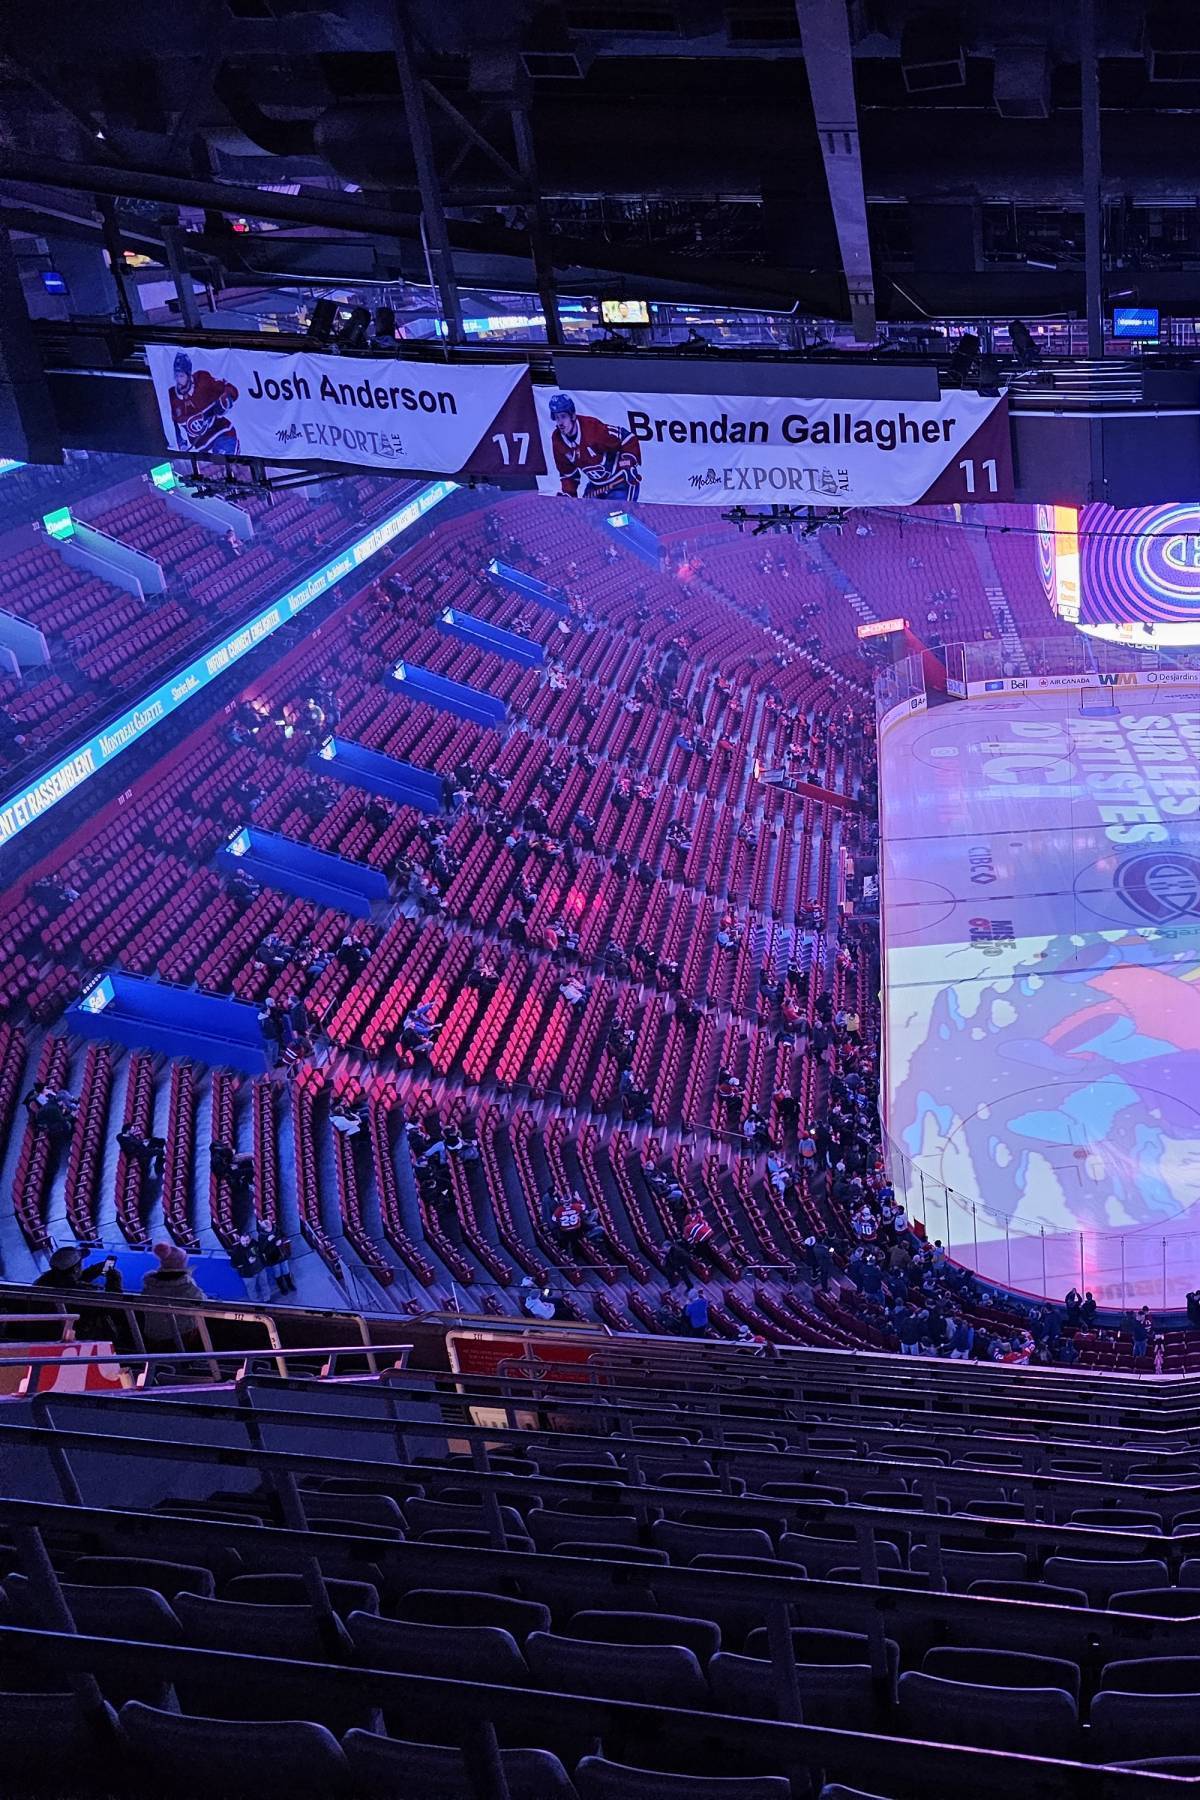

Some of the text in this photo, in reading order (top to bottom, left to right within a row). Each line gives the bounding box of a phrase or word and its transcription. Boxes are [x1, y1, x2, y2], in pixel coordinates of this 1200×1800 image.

[248, 370, 458, 416] Josh Anderson
[304, 423, 382, 451] EXPORT
[627, 410, 957, 451] Brendan Gallagher
[492, 432, 531, 466] 17
[722, 467, 820, 491] EXPORT
[839, 468, 850, 493] ALE
[959, 459, 998, 493] 11
[1011, 679, 1029, 690] Bell
[1062, 677, 1090, 685] CANADA
[1158, 672, 1199, 682] Desjardins
[98, 700, 165, 758] MONTREAL GAZETTE
[1119, 714, 1190, 763] SUR
[12, 798, 30, 825] ET
[28, 748, 97, 818] RASSEMBLENT
[1064, 717, 1170, 844] ARTISTES
[968, 846, 995, 873] CIBC
[560, 1213, 579, 1227] 29
[861, 1225, 872, 1235] 10
